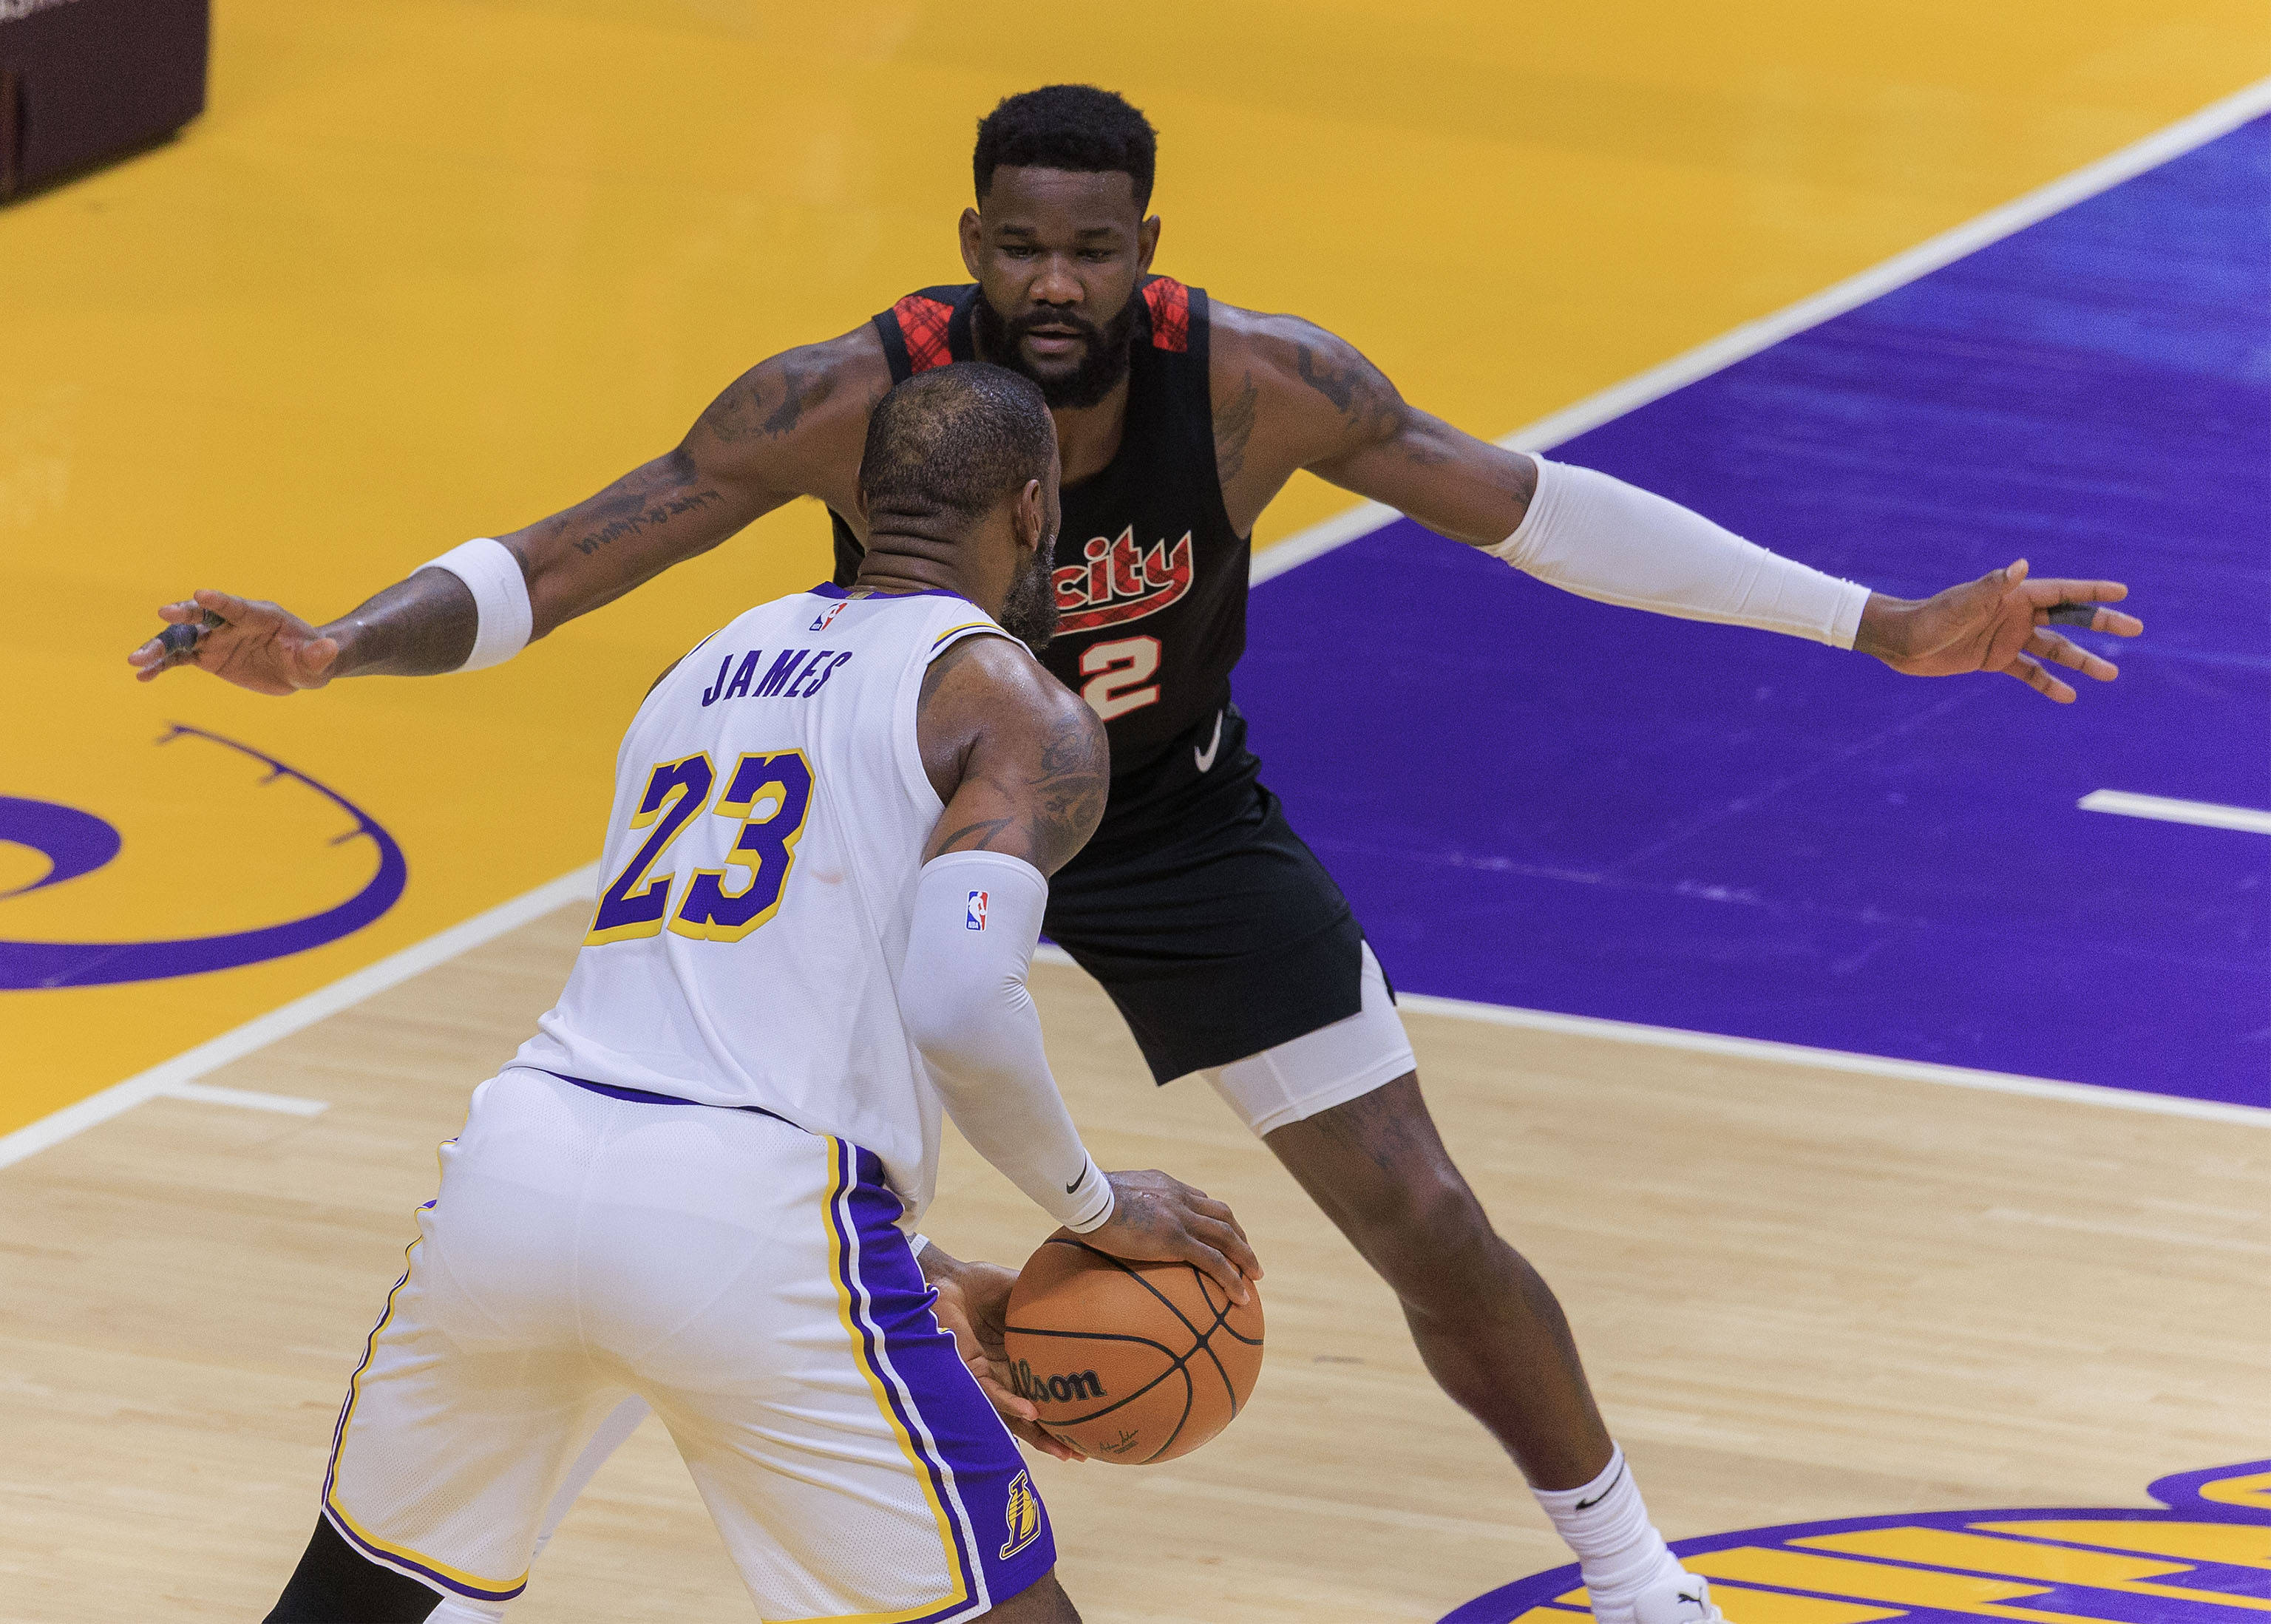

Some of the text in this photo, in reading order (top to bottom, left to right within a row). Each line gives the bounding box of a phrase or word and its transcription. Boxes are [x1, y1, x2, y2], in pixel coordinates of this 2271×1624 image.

[1050, 523, 1193, 636] city
[702, 649, 853, 707] JAMES
[1079, 634, 1161, 721] 2
[582, 747, 816, 947] 23
[1010, 1358, 1107, 1403] ilson
